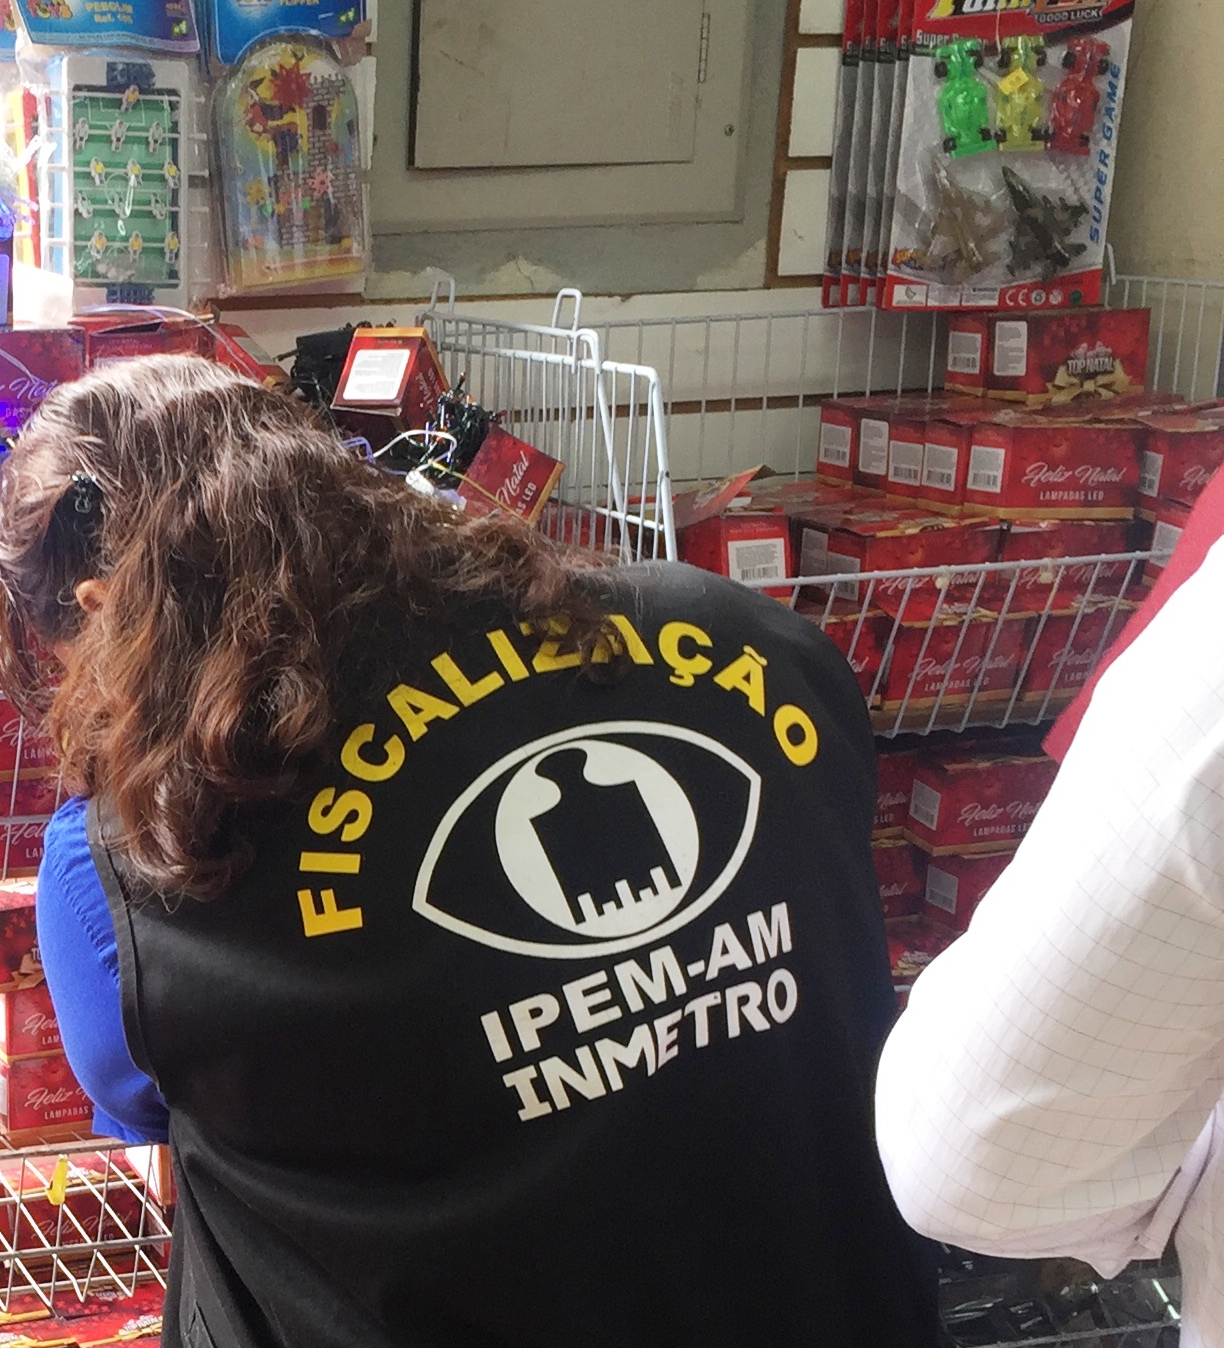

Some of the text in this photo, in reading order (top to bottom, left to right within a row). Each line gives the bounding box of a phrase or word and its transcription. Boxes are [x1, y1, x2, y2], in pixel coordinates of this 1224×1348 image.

[1089, 64, 1121, 244] SUPER GAME
[1068, 357, 1114, 374] TOP NATAL
[480, 901, 792, 1063] IPEM-AM
[502, 968, 799, 1123] INMETRO
[24, 1087, 75, 1111] Feliz
[44, 1106, 89, 1120] LAMPADAS
